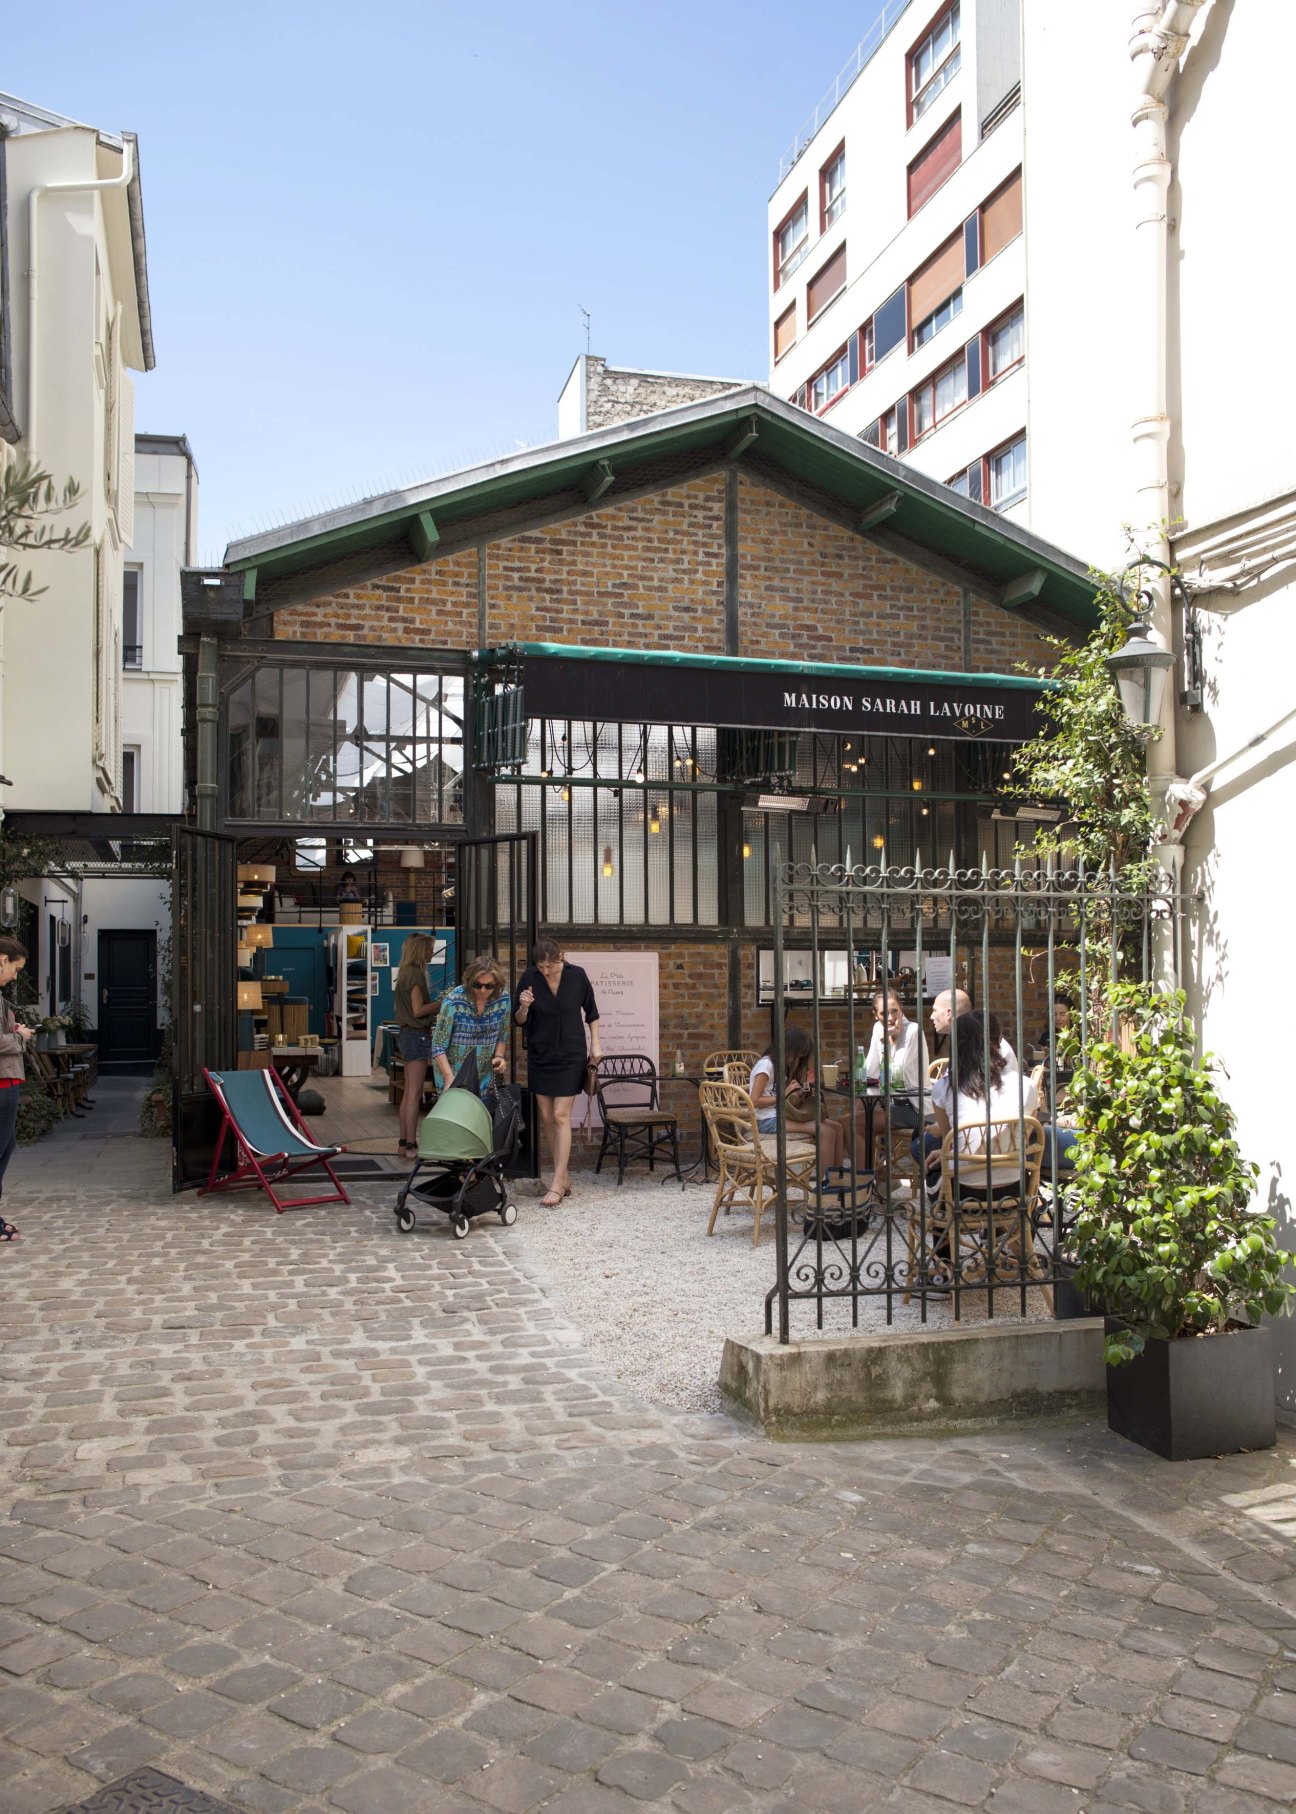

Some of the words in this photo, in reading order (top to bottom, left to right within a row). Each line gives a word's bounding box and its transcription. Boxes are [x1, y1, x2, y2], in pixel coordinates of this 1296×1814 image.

[783, 692, 854, 711] MAISON
[861, 697, 922, 715] SARAH
[929, 702, 1005, 720] LAVOINE
